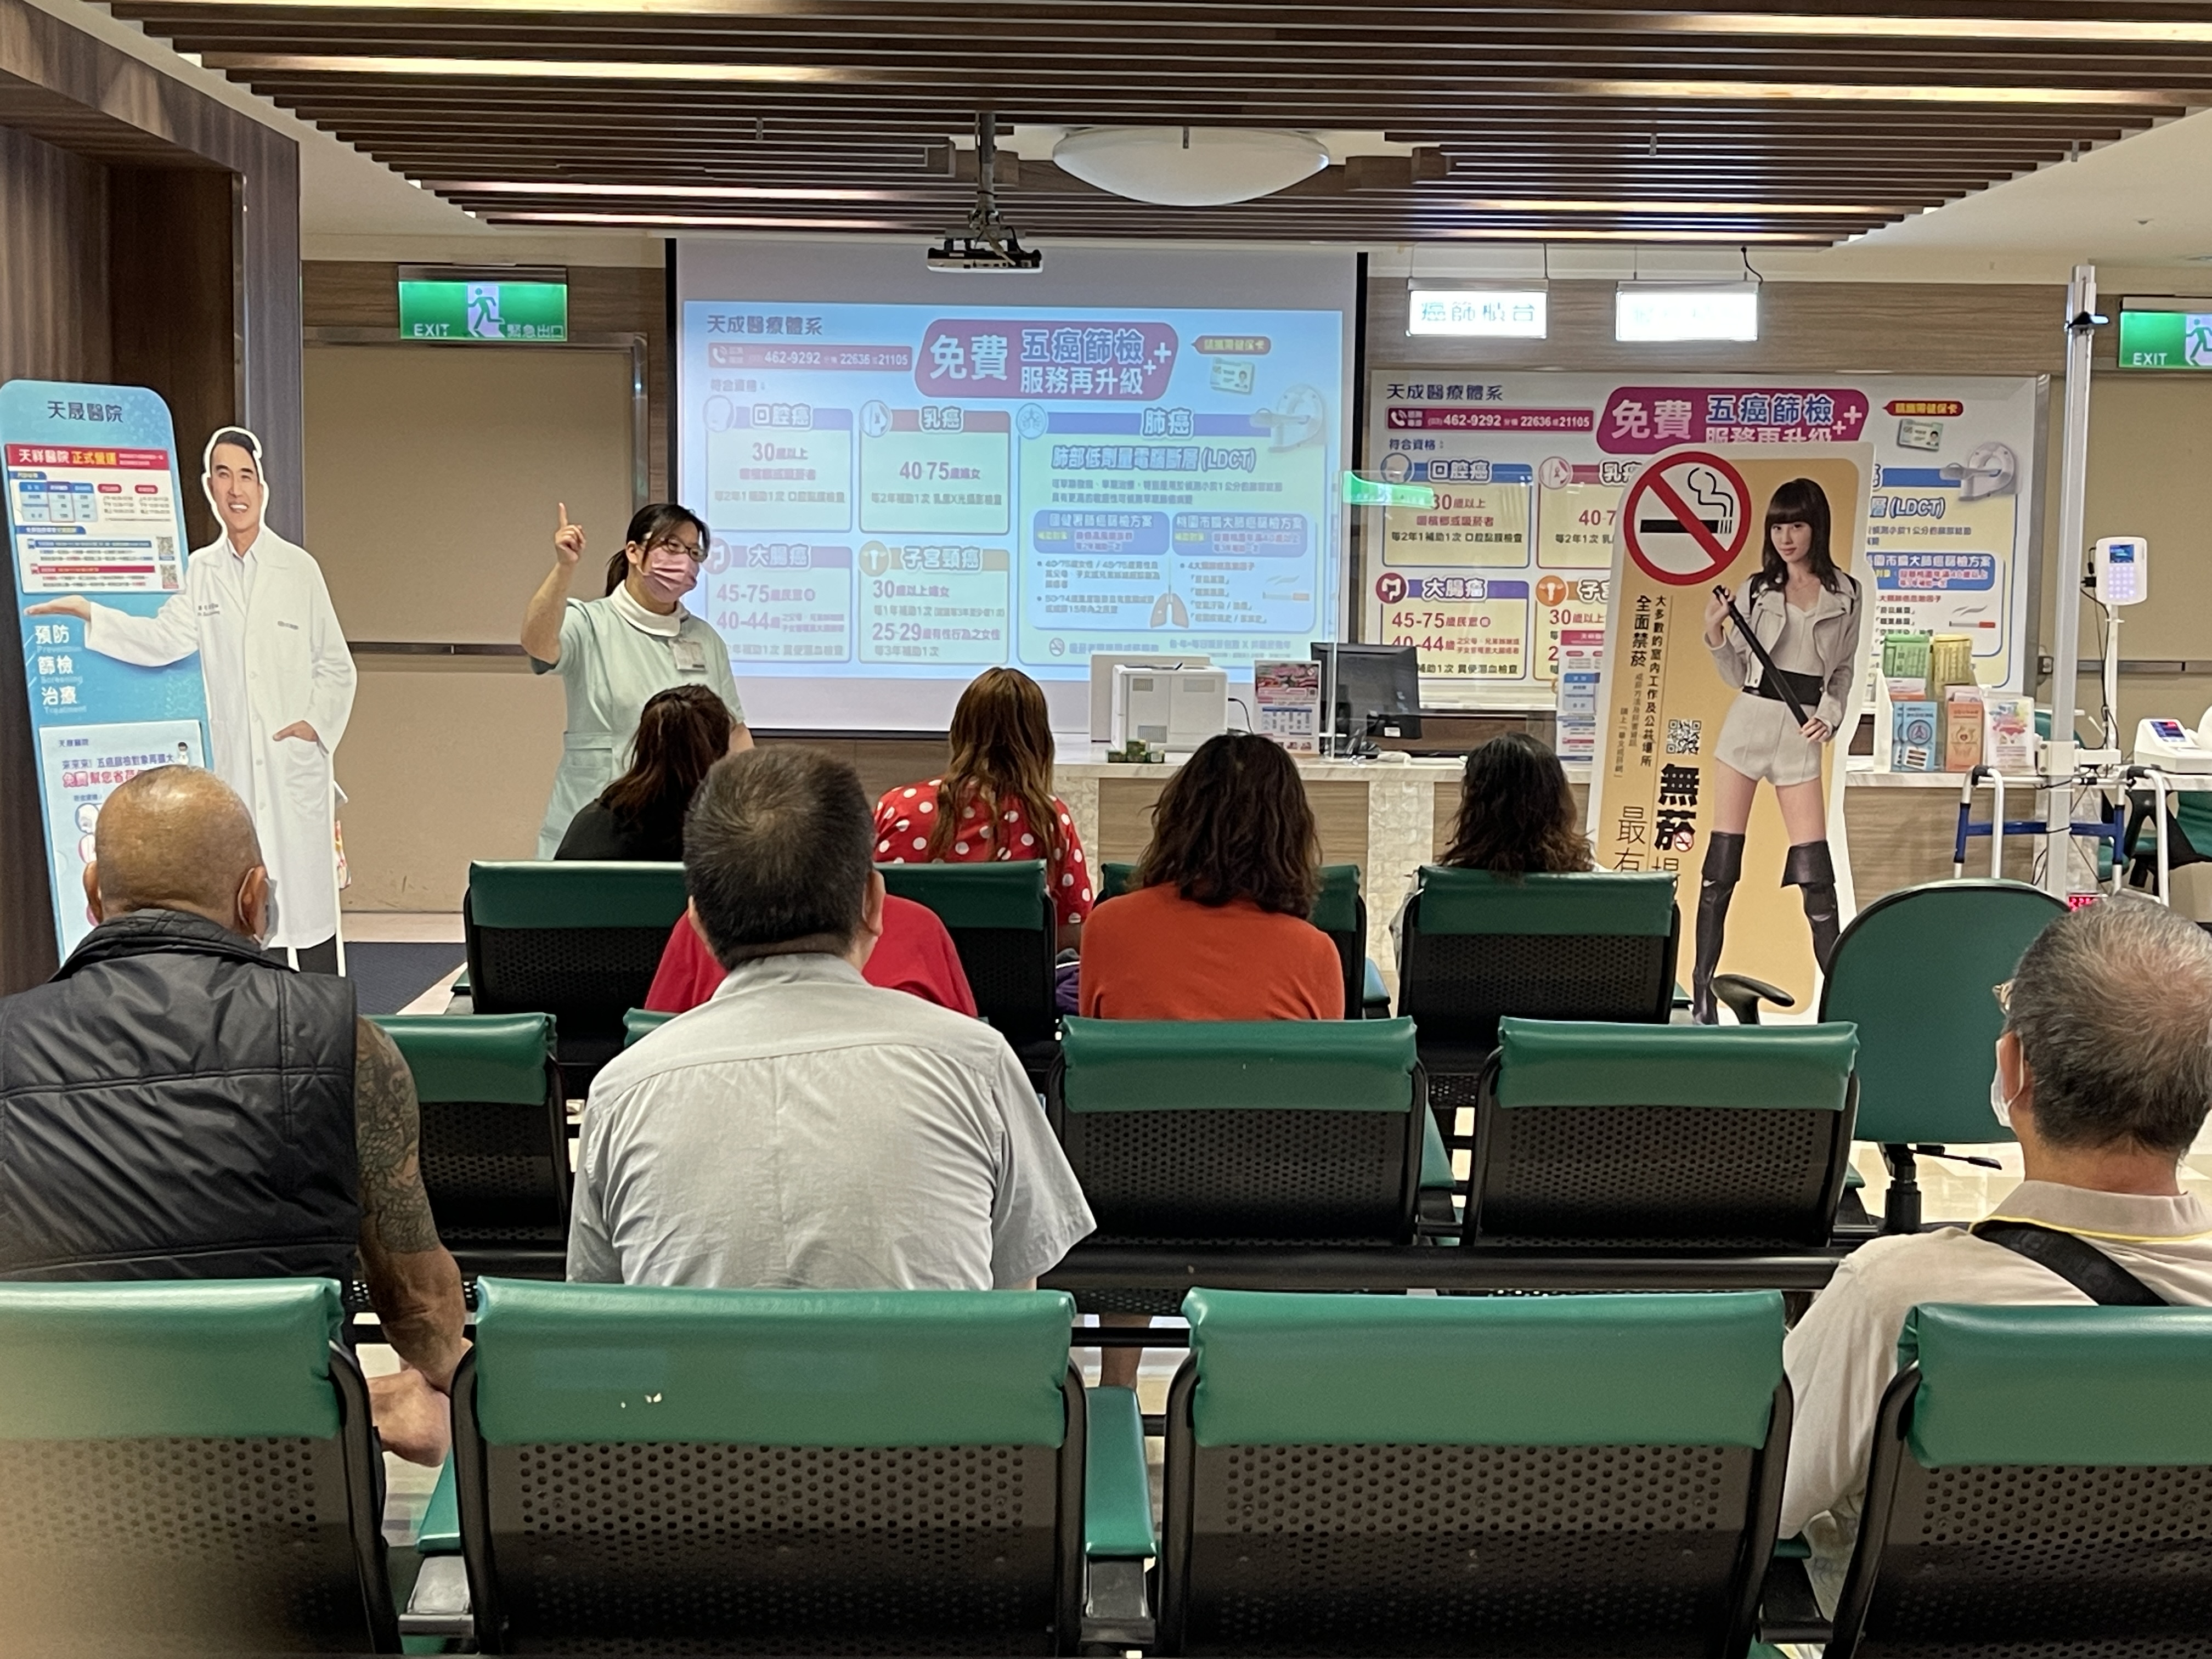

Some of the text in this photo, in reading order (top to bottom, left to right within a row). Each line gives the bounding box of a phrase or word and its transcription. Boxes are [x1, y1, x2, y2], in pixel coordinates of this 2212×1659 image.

[414, 323, 450, 337] EXIT
[707, 315, 822, 335] 天成醫療體系
[930, 334, 1008, 381] 免費
[1021, 328, 1144, 364] 五癌篩檢
[2132, 352, 2168, 366] EXIT
[1021, 366, 1144, 395] 服務再升級
[1387, 384, 1503, 401] 天成醫療體系
[47, 400, 124, 423] 天晟醫院
[752, 403, 812, 428] 口腔癌
[921, 405, 962, 431] 乳癌
[1611, 399, 1693, 441] 免費
[1706, 393, 1835, 425] 五癌篩檢
[1142, 407, 1193, 438] 肺癌
[1443, 414, 1502, 427] 462-9292
[1521, 416, 1551, 427] 22636
[1559, 416, 1590, 428] 21105
[1201, 448, 1257, 472] (LDCT)
[1429, 460, 1491, 483] 口腔癌
[1889, 496, 1946, 519] (LDCT)
[1602, 534, 1615, 544] 乳
[748, 544, 811, 569] 大腸癌
[1424, 578, 1487, 600] 大腸癌
[34, 624, 70, 645] 預防
[1630, 595, 1652, 668] 全面禁菸
[37, 654, 74, 675] 篩檢
[41, 686, 77, 706] 治療
